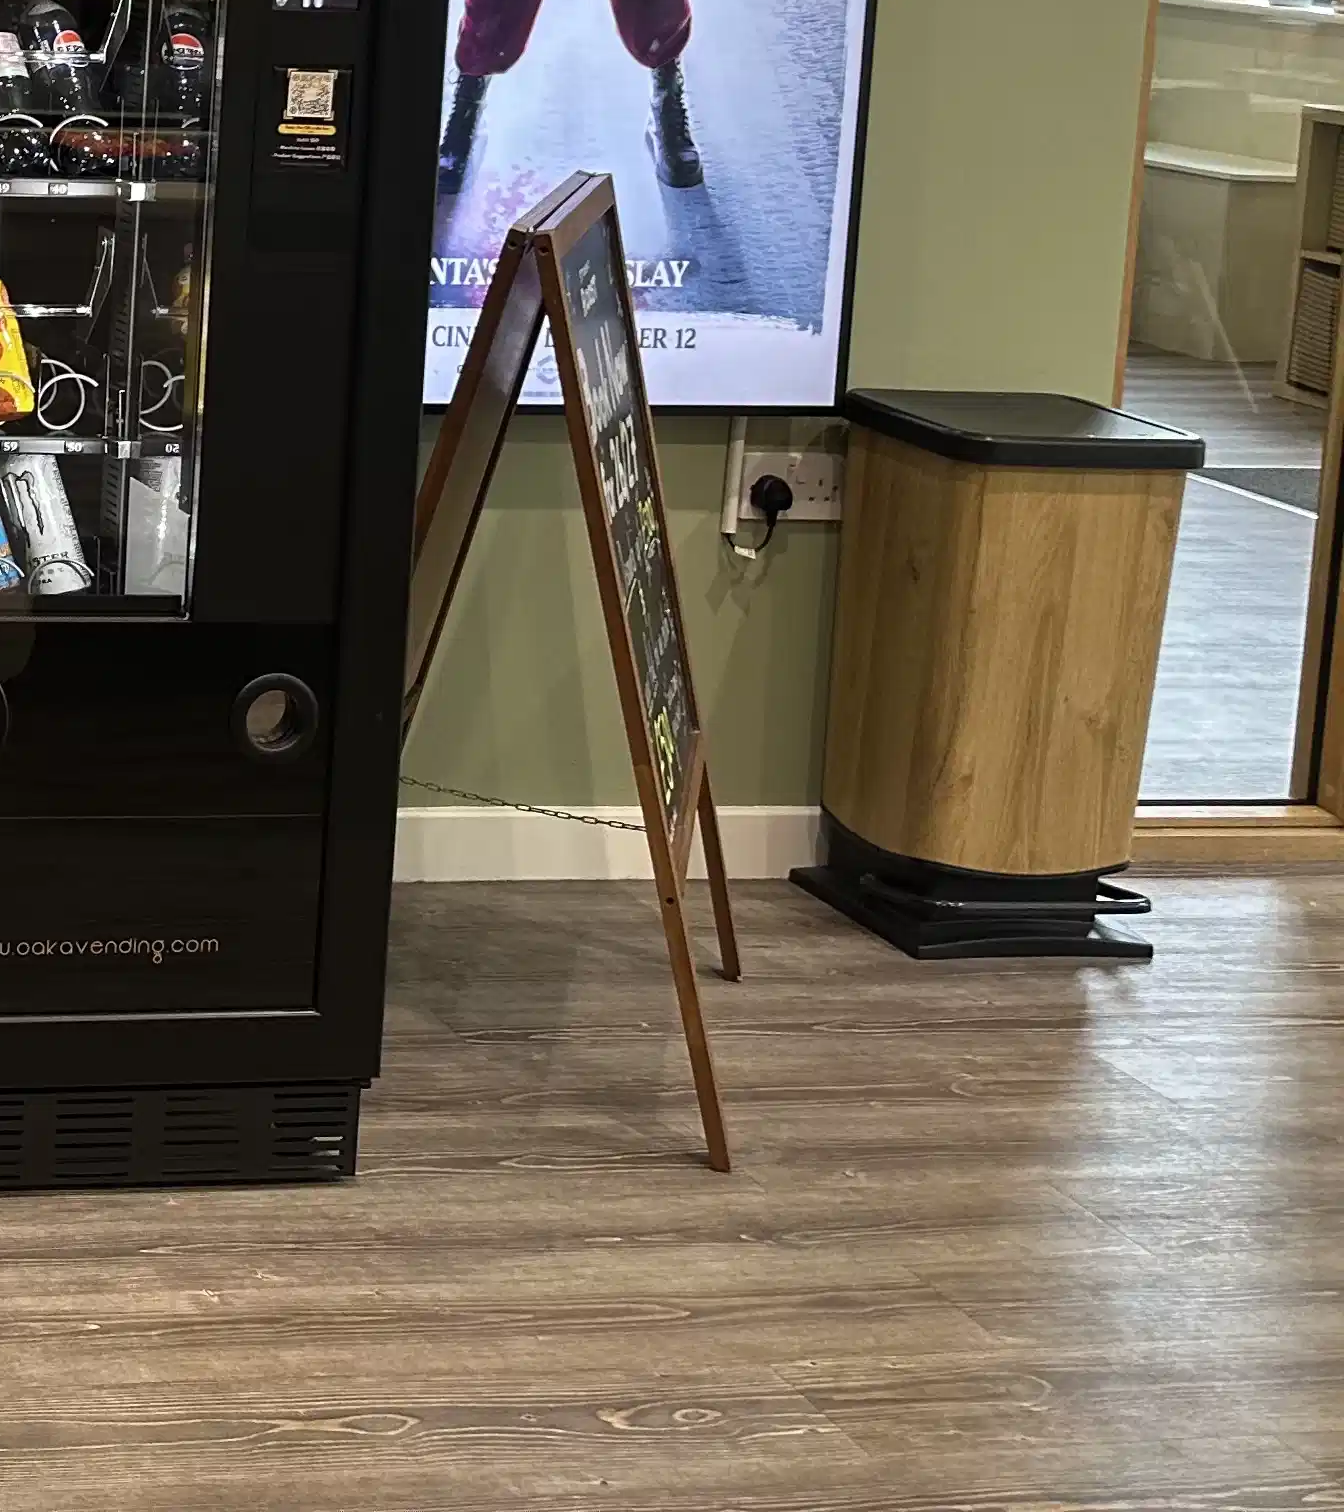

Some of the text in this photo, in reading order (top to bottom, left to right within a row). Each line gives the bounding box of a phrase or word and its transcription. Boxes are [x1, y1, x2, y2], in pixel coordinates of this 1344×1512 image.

[430, 258, 499, 287] NTA'S
[675, 327, 697, 349] 12
[3, 441, 18, 451] 59
[67, 442, 82, 453] 50
